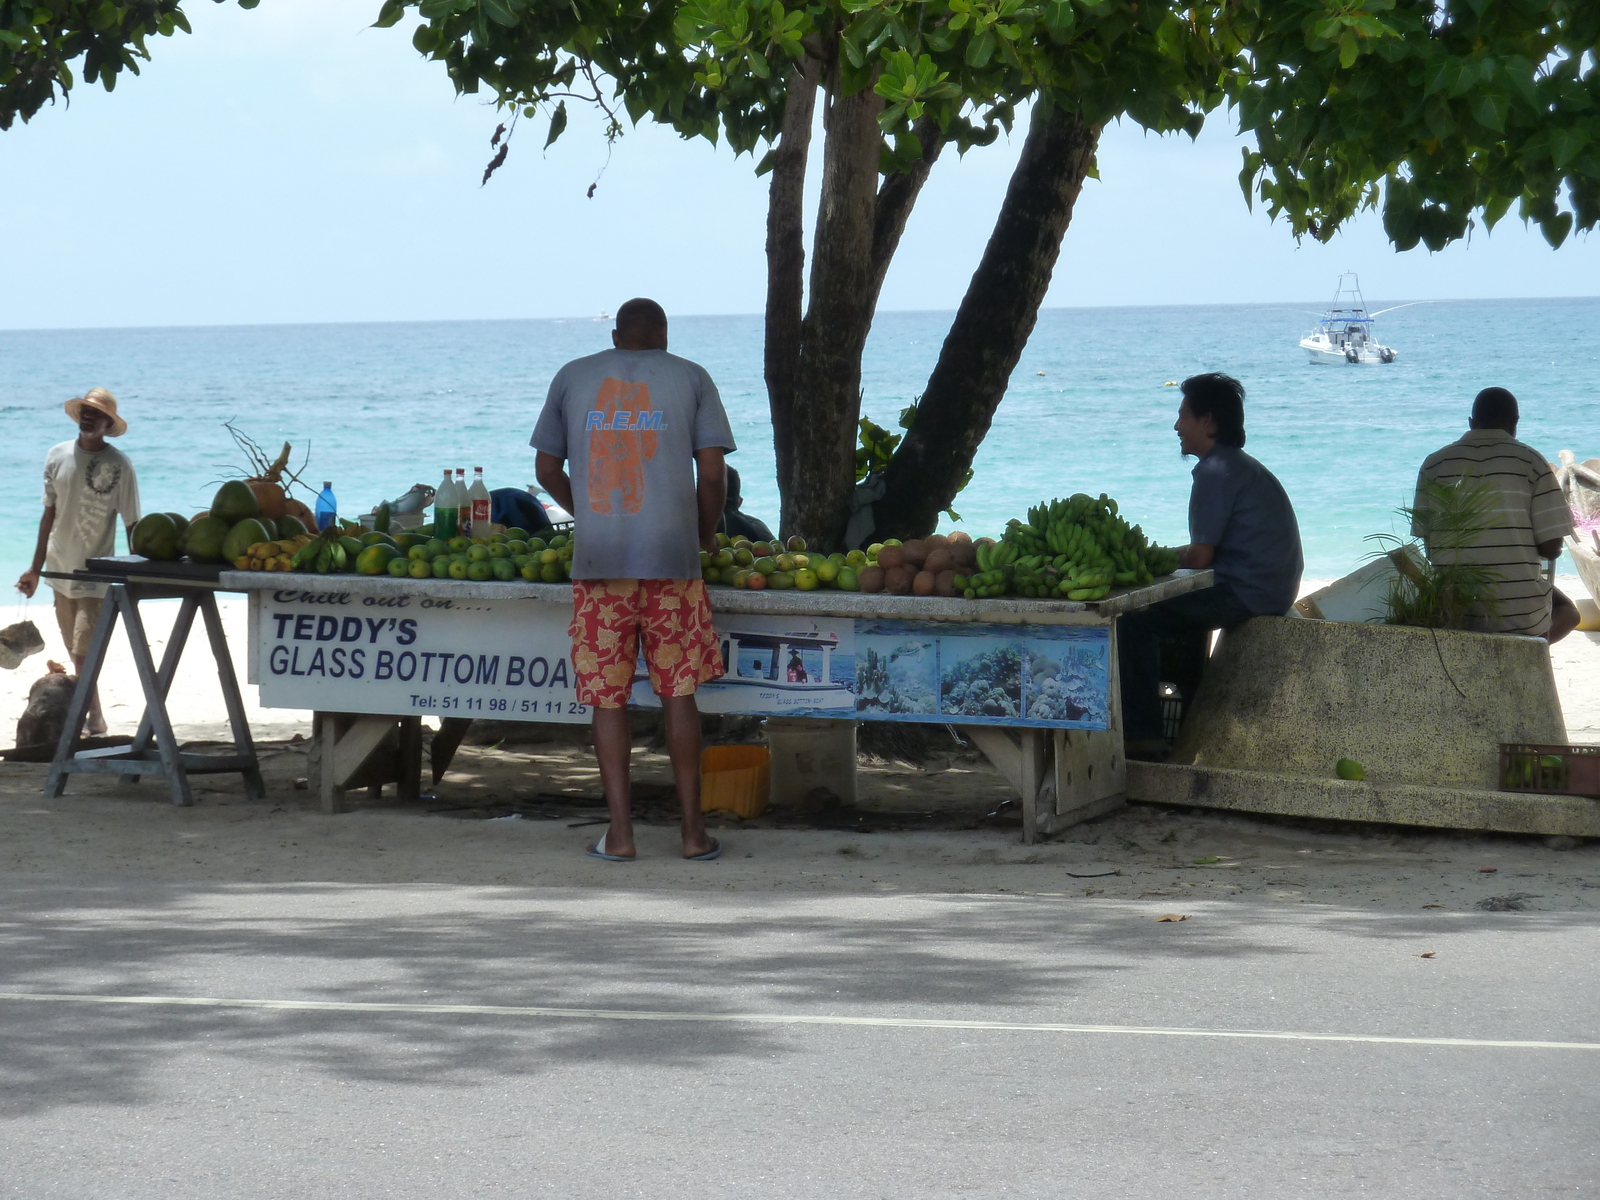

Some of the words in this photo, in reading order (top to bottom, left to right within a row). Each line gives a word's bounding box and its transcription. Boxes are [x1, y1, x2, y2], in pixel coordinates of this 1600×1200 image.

[585, 411, 668, 431] R.E.M.
[273, 590, 351, 606] Chill
[362, 594, 411, 608] out
[272, 613, 417, 645] TEDDY'S
[269, 645, 366, 679] GLASS
[374, 650, 500, 685] BOTTOM
[505, 656, 578, 689] BOA
[410, 695, 437, 708] Tel:
[442, 696, 459, 709] 51
[466, 698, 483, 710] 11
[489, 698, 506, 711] 98
[521, 700, 538, 713] 51
[545, 701, 562, 714] 11
[568, 702, 587, 715] 25
